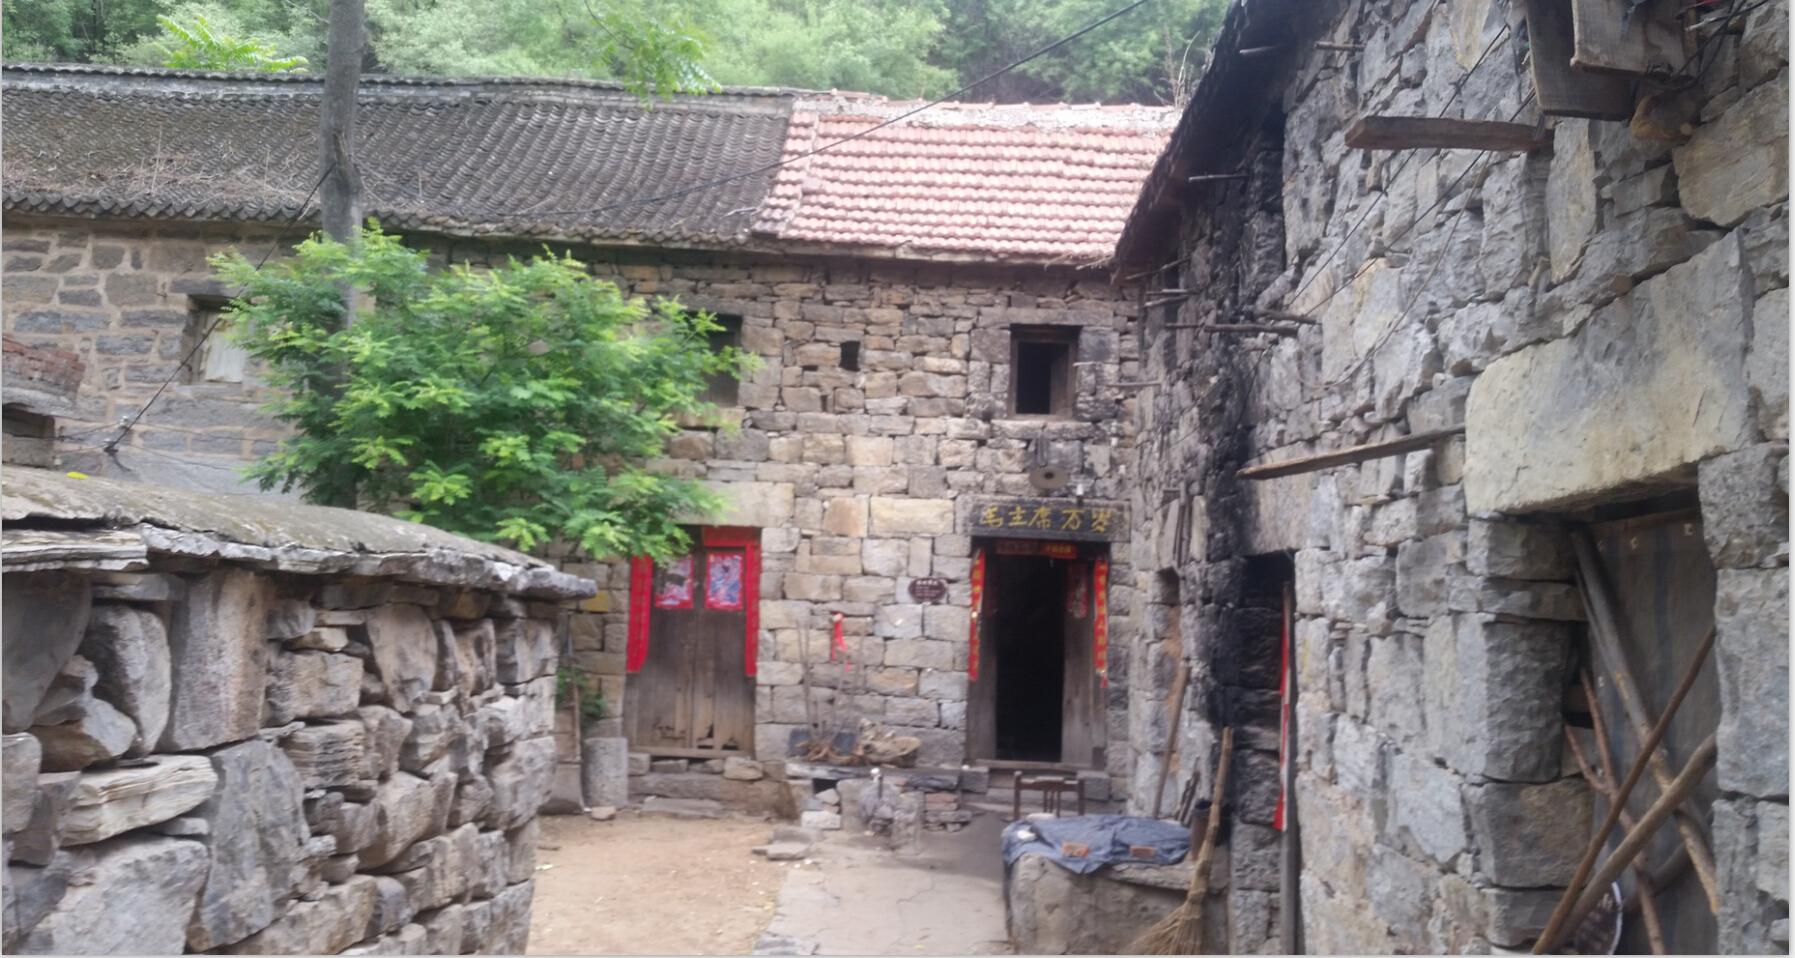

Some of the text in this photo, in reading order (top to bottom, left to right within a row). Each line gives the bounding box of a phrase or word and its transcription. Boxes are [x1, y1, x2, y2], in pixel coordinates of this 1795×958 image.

[981, 504, 1112, 533] 毛主席万岁
